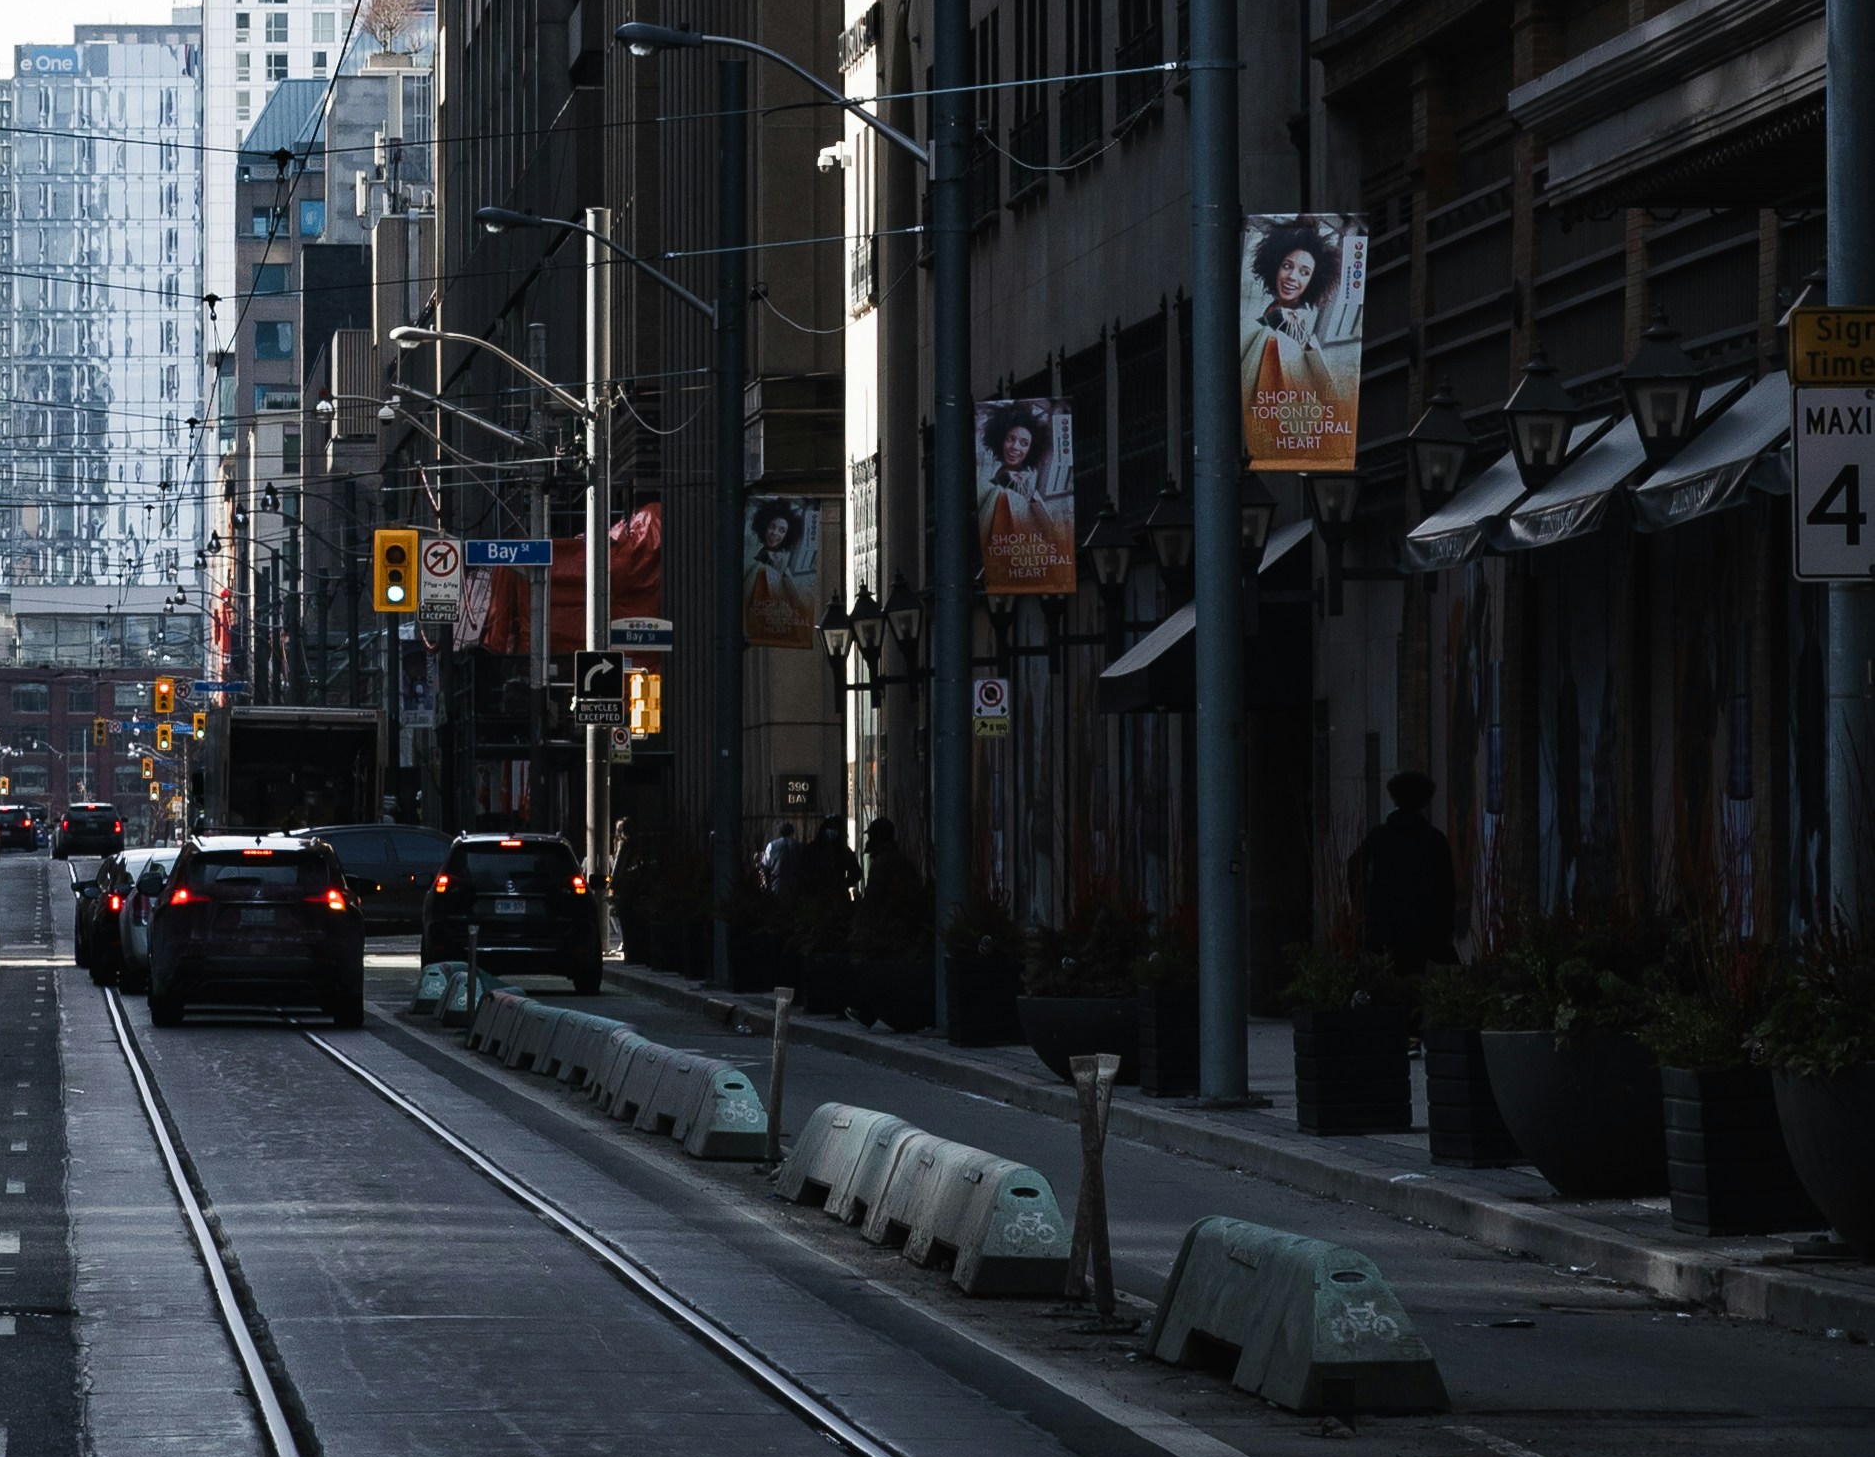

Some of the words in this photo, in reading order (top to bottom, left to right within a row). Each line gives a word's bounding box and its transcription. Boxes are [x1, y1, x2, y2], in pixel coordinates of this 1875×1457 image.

[36, 55, 73, 71] One
[1257, 390, 1298, 404] SHOP
[1302, 390, 1317, 404] IN
[1251, 405, 1335, 419] TORONTO'S
[1279, 421, 1353, 434] CULTURAL
[1276, 436, 1322, 449] HEART
[1806, 464, 1867, 545] 4
[991, 533, 1026, 545] SHOP
[1029, 532, 1043, 543] IN
[488, 543, 517, 563] Bay
[521, 543, 530, 552] St
[987, 543, 1057, 556] TORONTO'S
[1010, 554, 1073, 567] CULTURAL
[1008, 567, 1048, 578] HEART
[421, 612, 457, 621] EXCEPTED
[626, 631, 643, 643] Bay
[648, 632, 655, 641] St
[578, 713, 620, 722] EXCEPTED
[788, 781, 810, 791] 390
[788, 794, 807, 804] BAY
